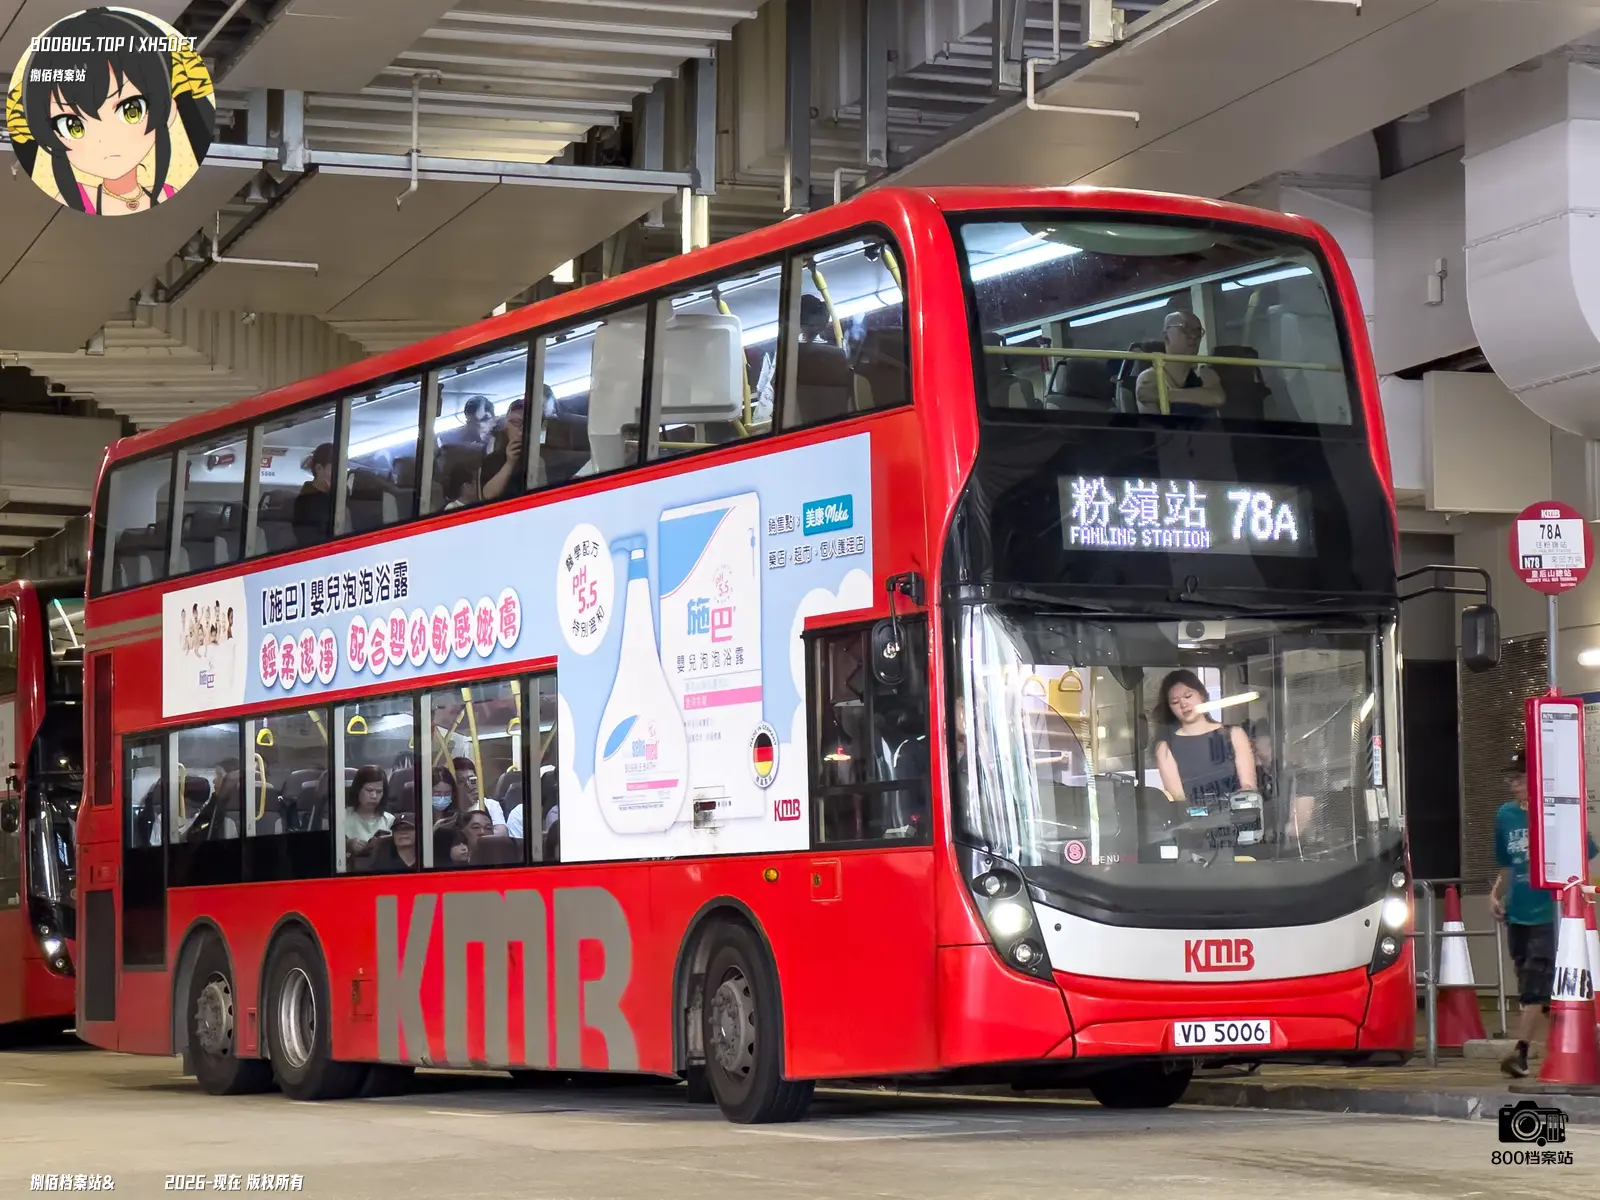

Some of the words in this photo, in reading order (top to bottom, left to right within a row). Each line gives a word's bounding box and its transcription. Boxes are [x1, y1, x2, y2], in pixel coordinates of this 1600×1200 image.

[1070, 476, 1207, 528] 粉嶺站
[1227, 487, 1299, 541] 78A
[1070, 526, 1138, 547] FANLING
[1142, 528, 1211, 549] STATION
[1540, 524, 1562, 540] 78A
[1524, 557, 1540, 568] N78
[572, 565, 587, 596] pH
[578, 580, 598, 614] 5.5
[687, 597, 733, 643] 施巴
[261, 635, 334, 681] 輕柔潔淨
[773, 798, 801, 822] KMB
[1184, 938, 1256, 973] KMB
[1181, 1024, 1206, 1043] VD
[1214, 1022, 1265, 1042] 5006
